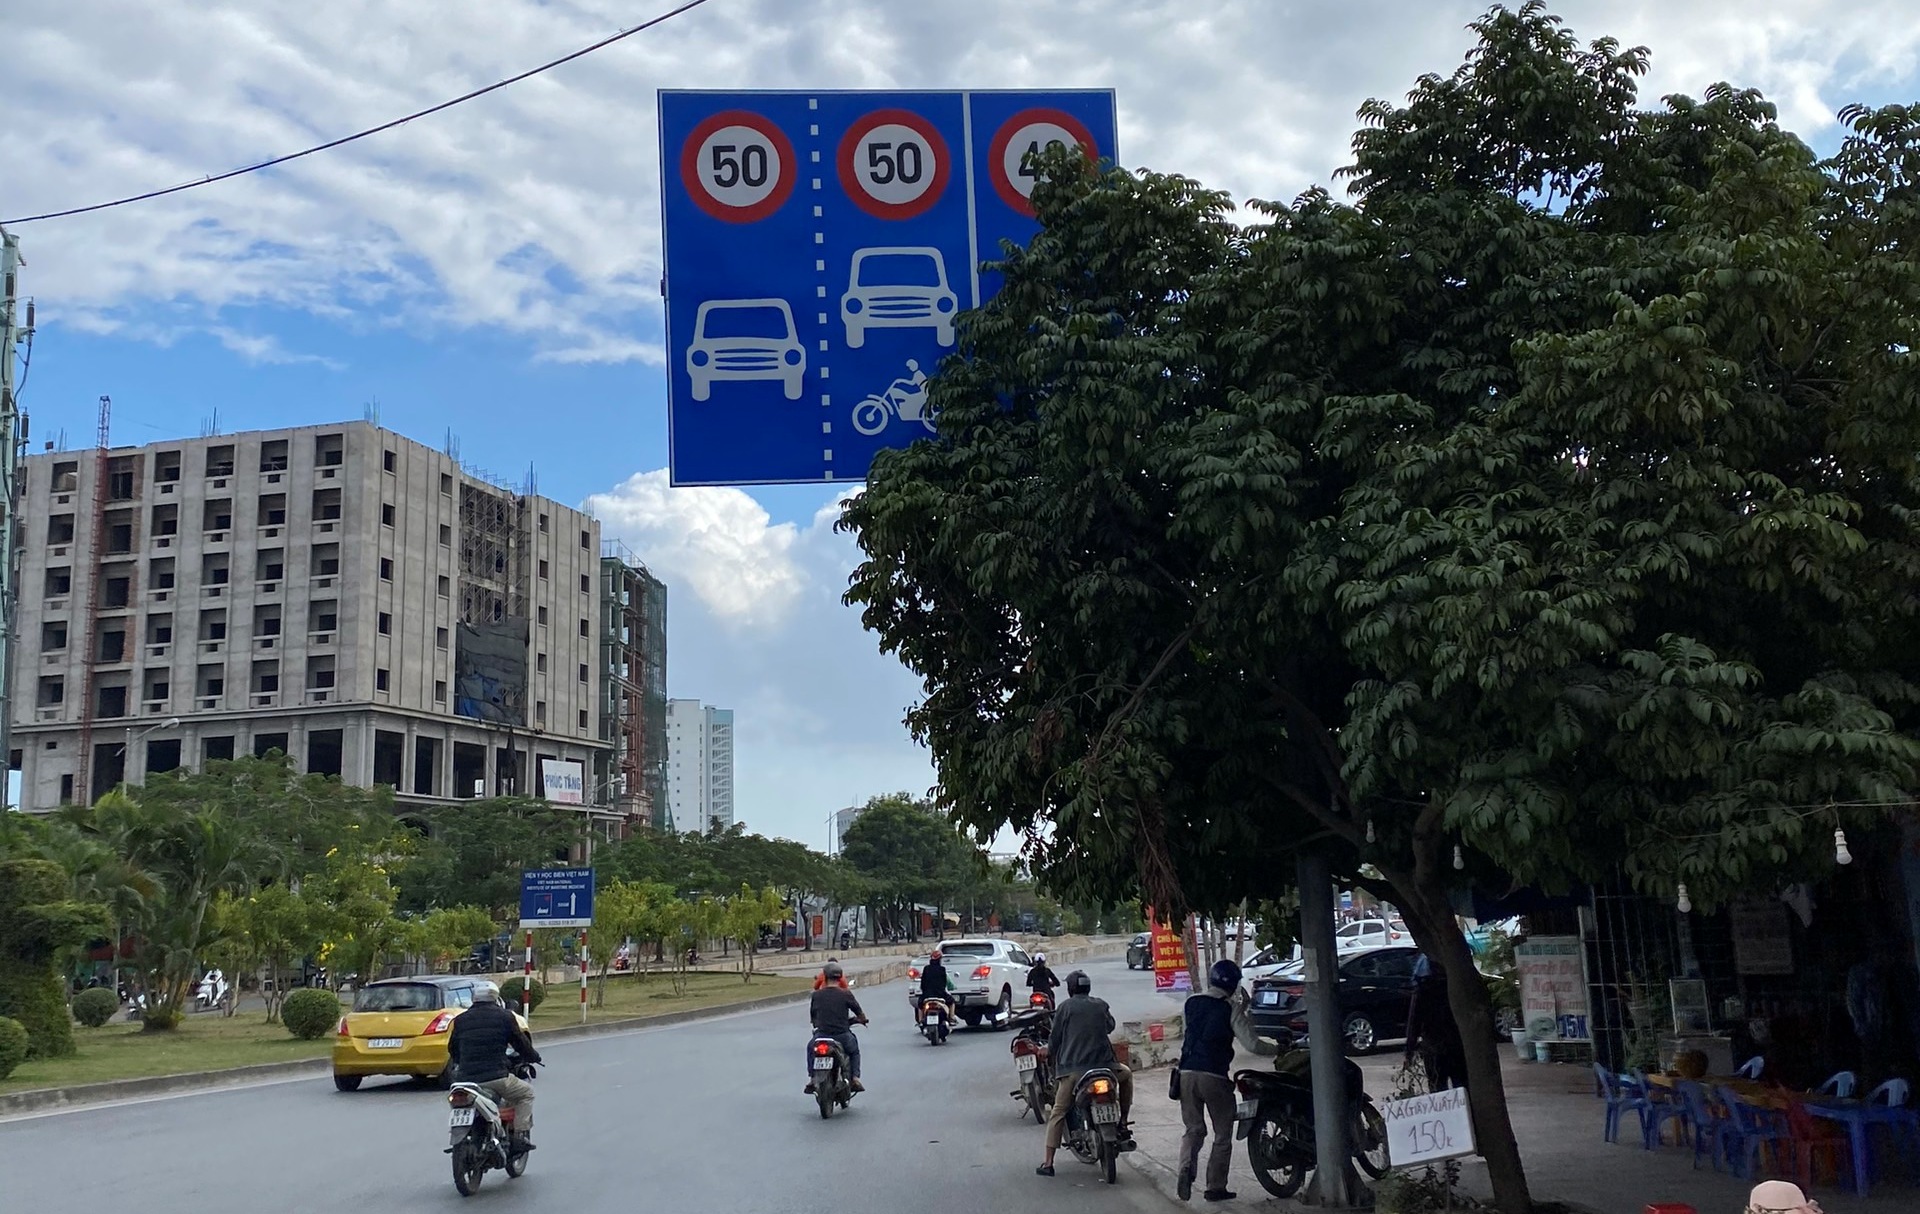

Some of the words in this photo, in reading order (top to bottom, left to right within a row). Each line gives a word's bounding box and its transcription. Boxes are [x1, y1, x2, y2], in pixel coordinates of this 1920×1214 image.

[712, 144, 768, 187] 50
[868, 141, 922, 185] 50
[566, 870, 577, 878] VIỆT
